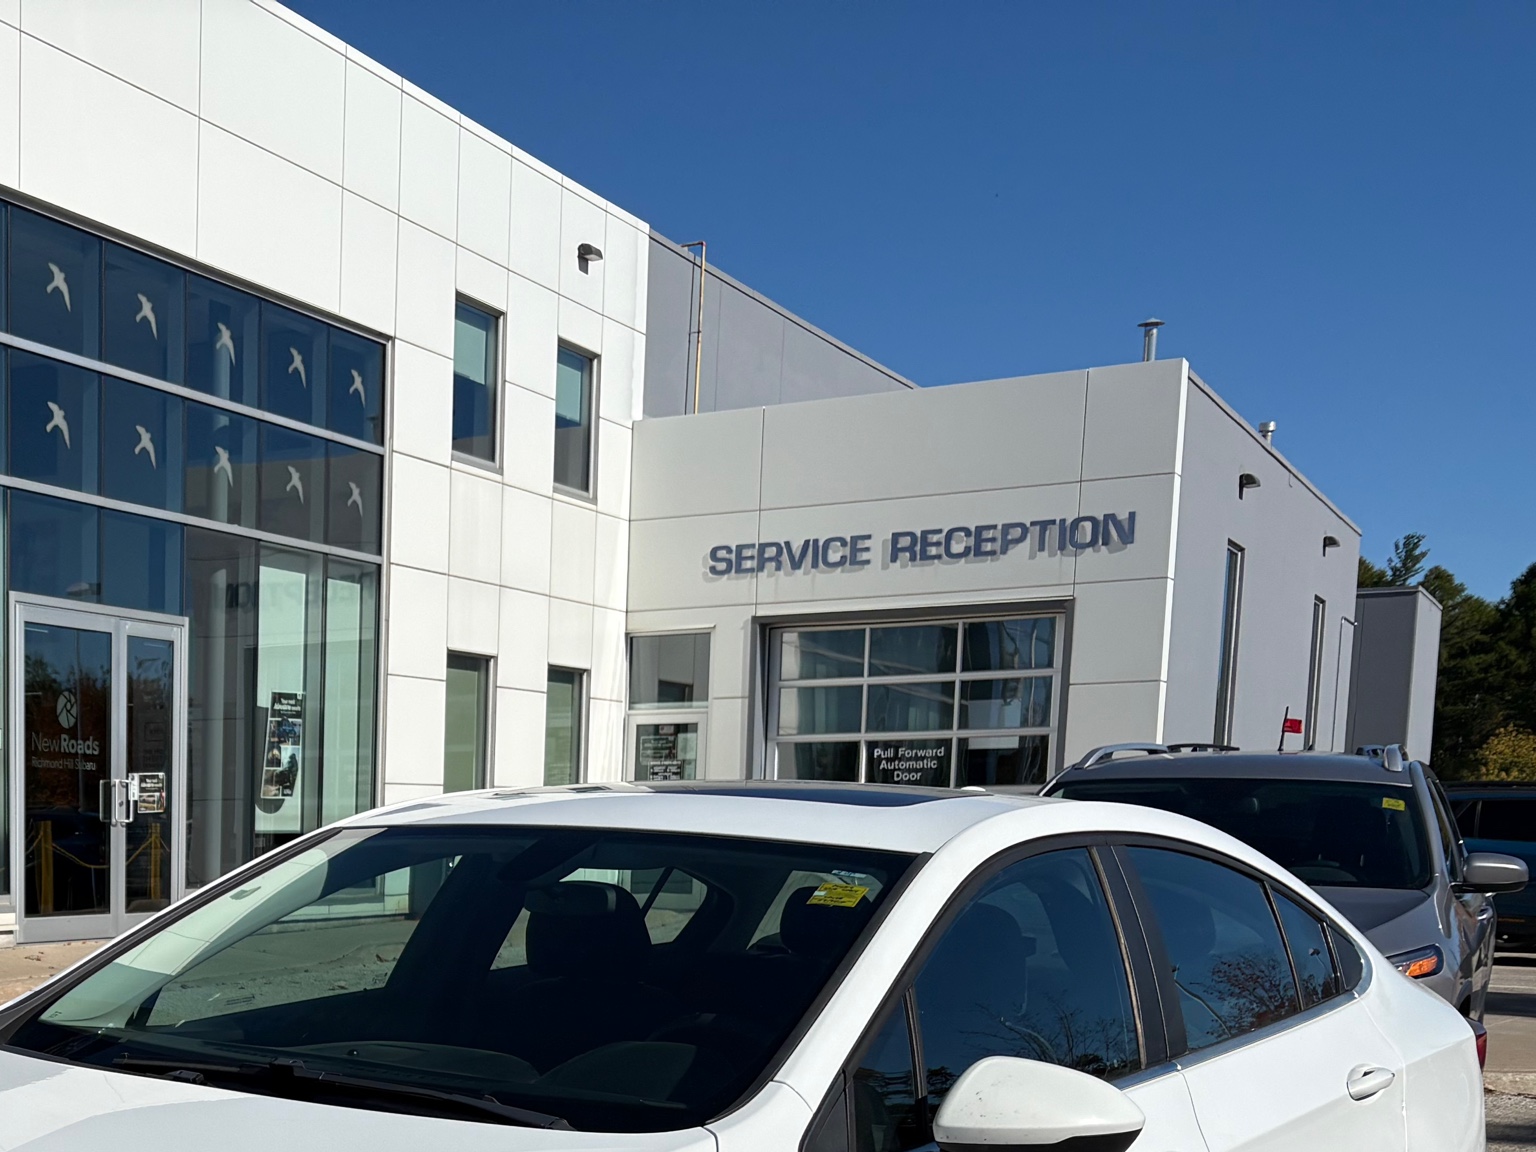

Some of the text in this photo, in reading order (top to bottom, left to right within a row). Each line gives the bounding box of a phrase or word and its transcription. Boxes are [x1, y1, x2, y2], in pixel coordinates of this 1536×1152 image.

[709, 511, 1136, 576] SERVICE RECEPTION
[873, 746, 945, 759] Pull Forward
[31, 755, 63, 769] Richmond
[75, 758, 97, 771] Subaru
[879, 758, 938, 770] Automatic
[893, 770, 922, 781] Door
